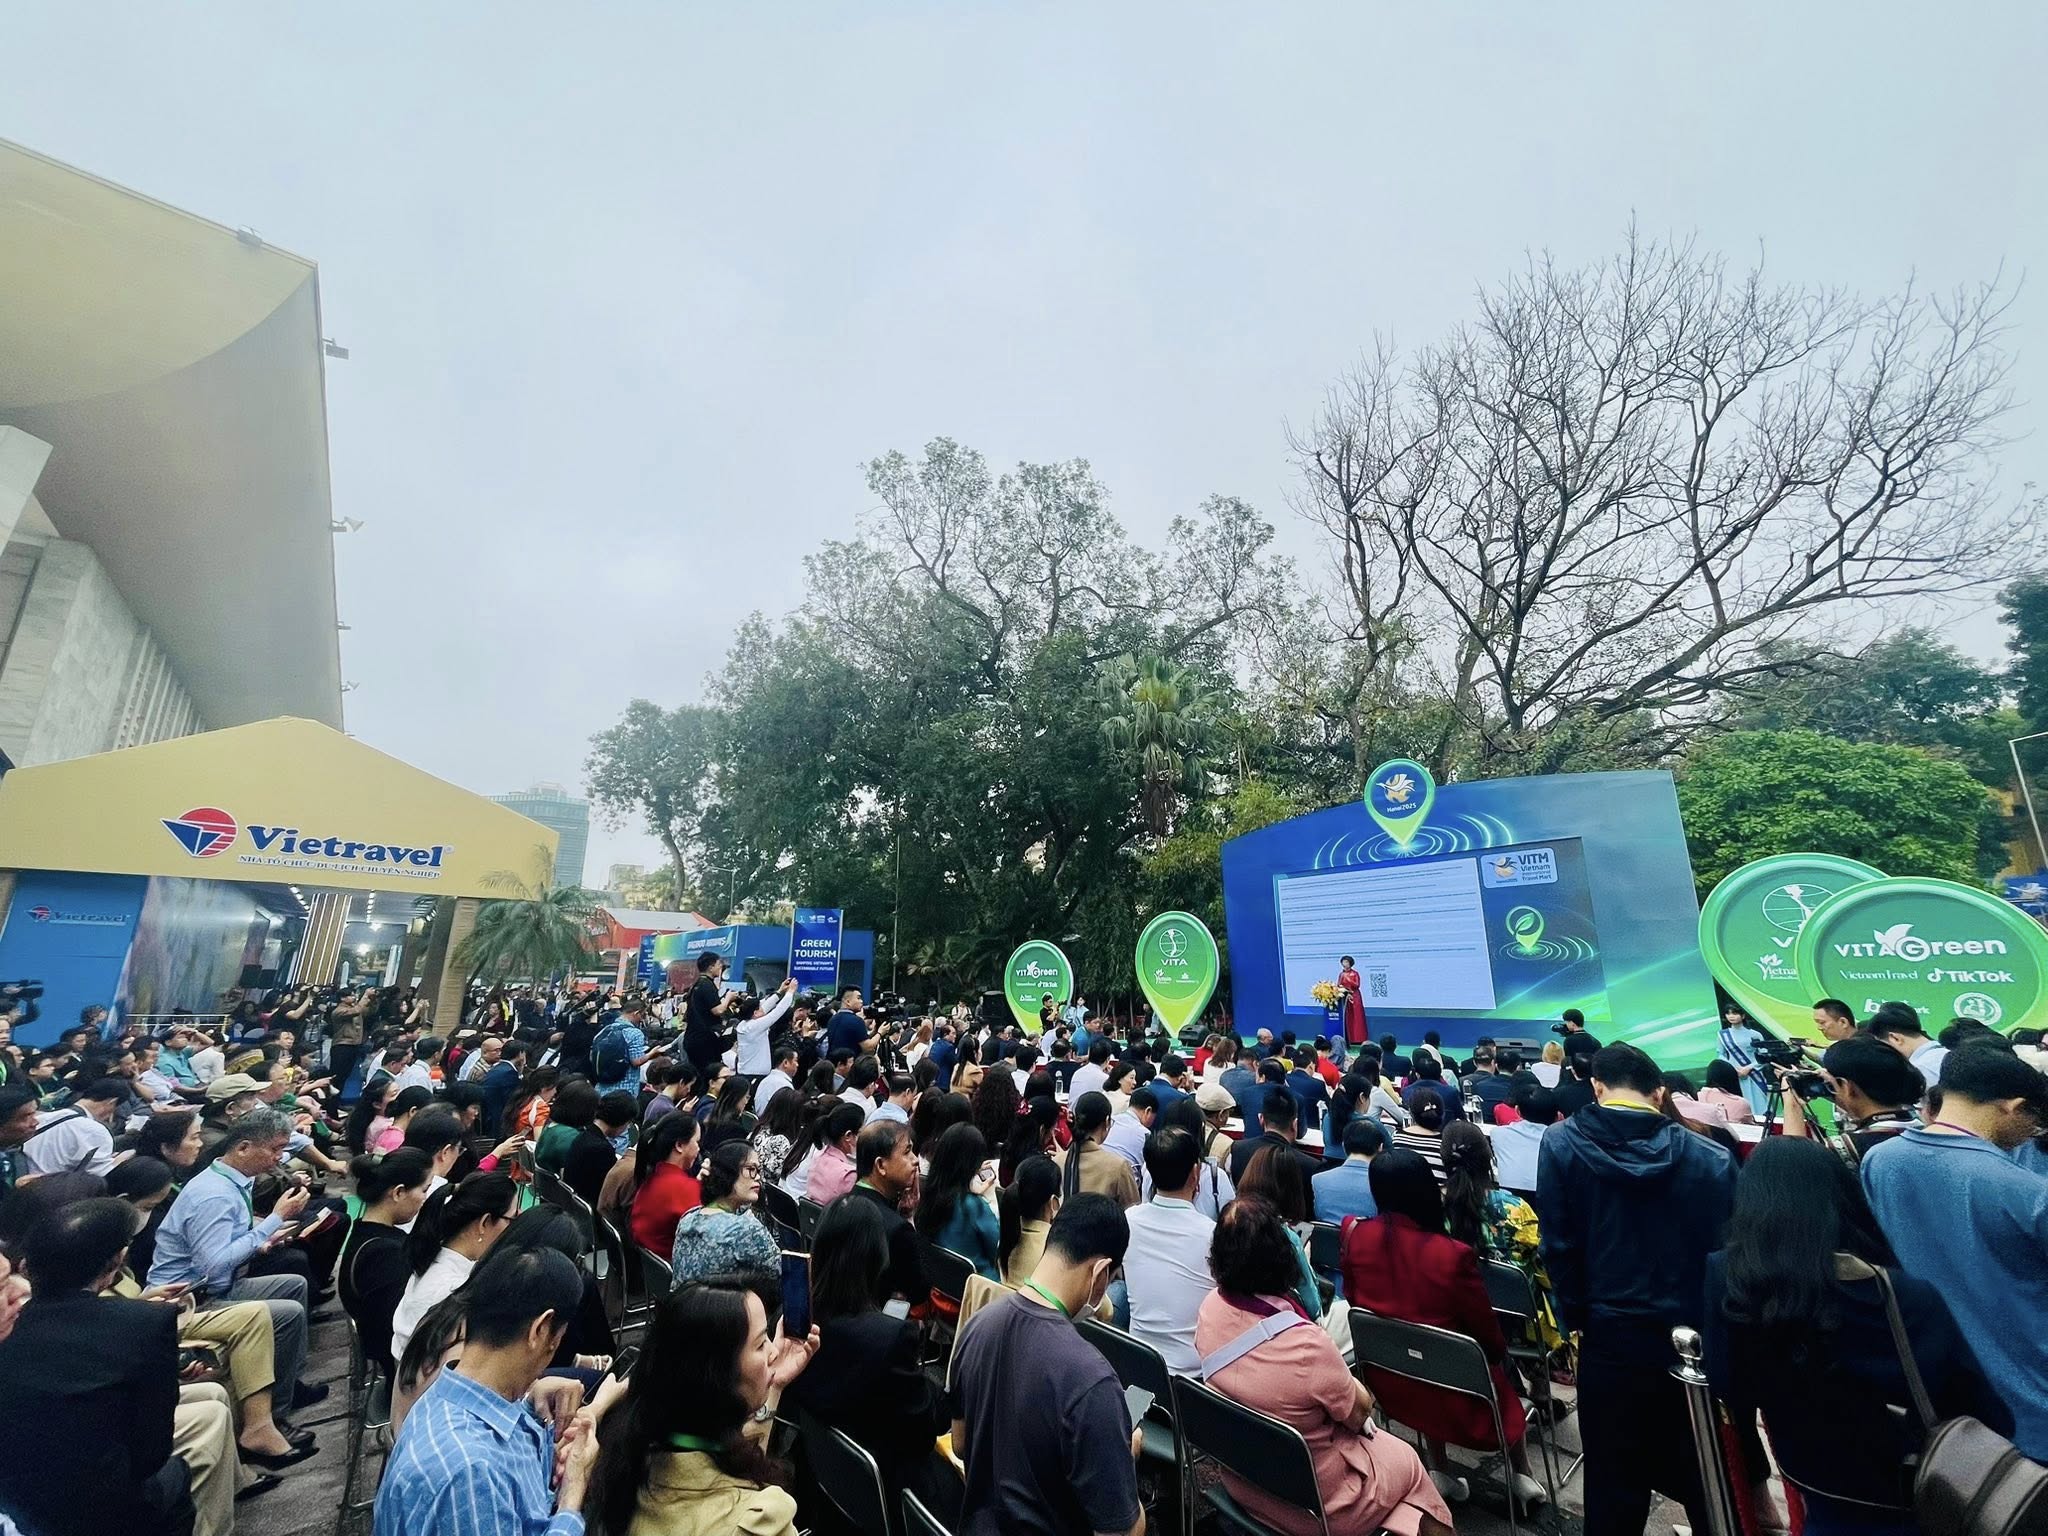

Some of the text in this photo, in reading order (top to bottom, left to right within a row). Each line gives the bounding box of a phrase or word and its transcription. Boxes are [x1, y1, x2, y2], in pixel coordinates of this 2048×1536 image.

[246, 825, 444, 867] Vietravel
[1518, 852, 1549, 865] VITM
[1521, 864, 1550, 872] Vietnam
[54, 911, 127, 922] Vietravel
[800, 939, 832, 948] GREEN
[1834, 936, 2008, 962] VITAGreen
[794, 949, 837, 958] TOURISM
[1161, 958, 1188, 966] VITA
[1949, 970, 2015, 983] TikTok
